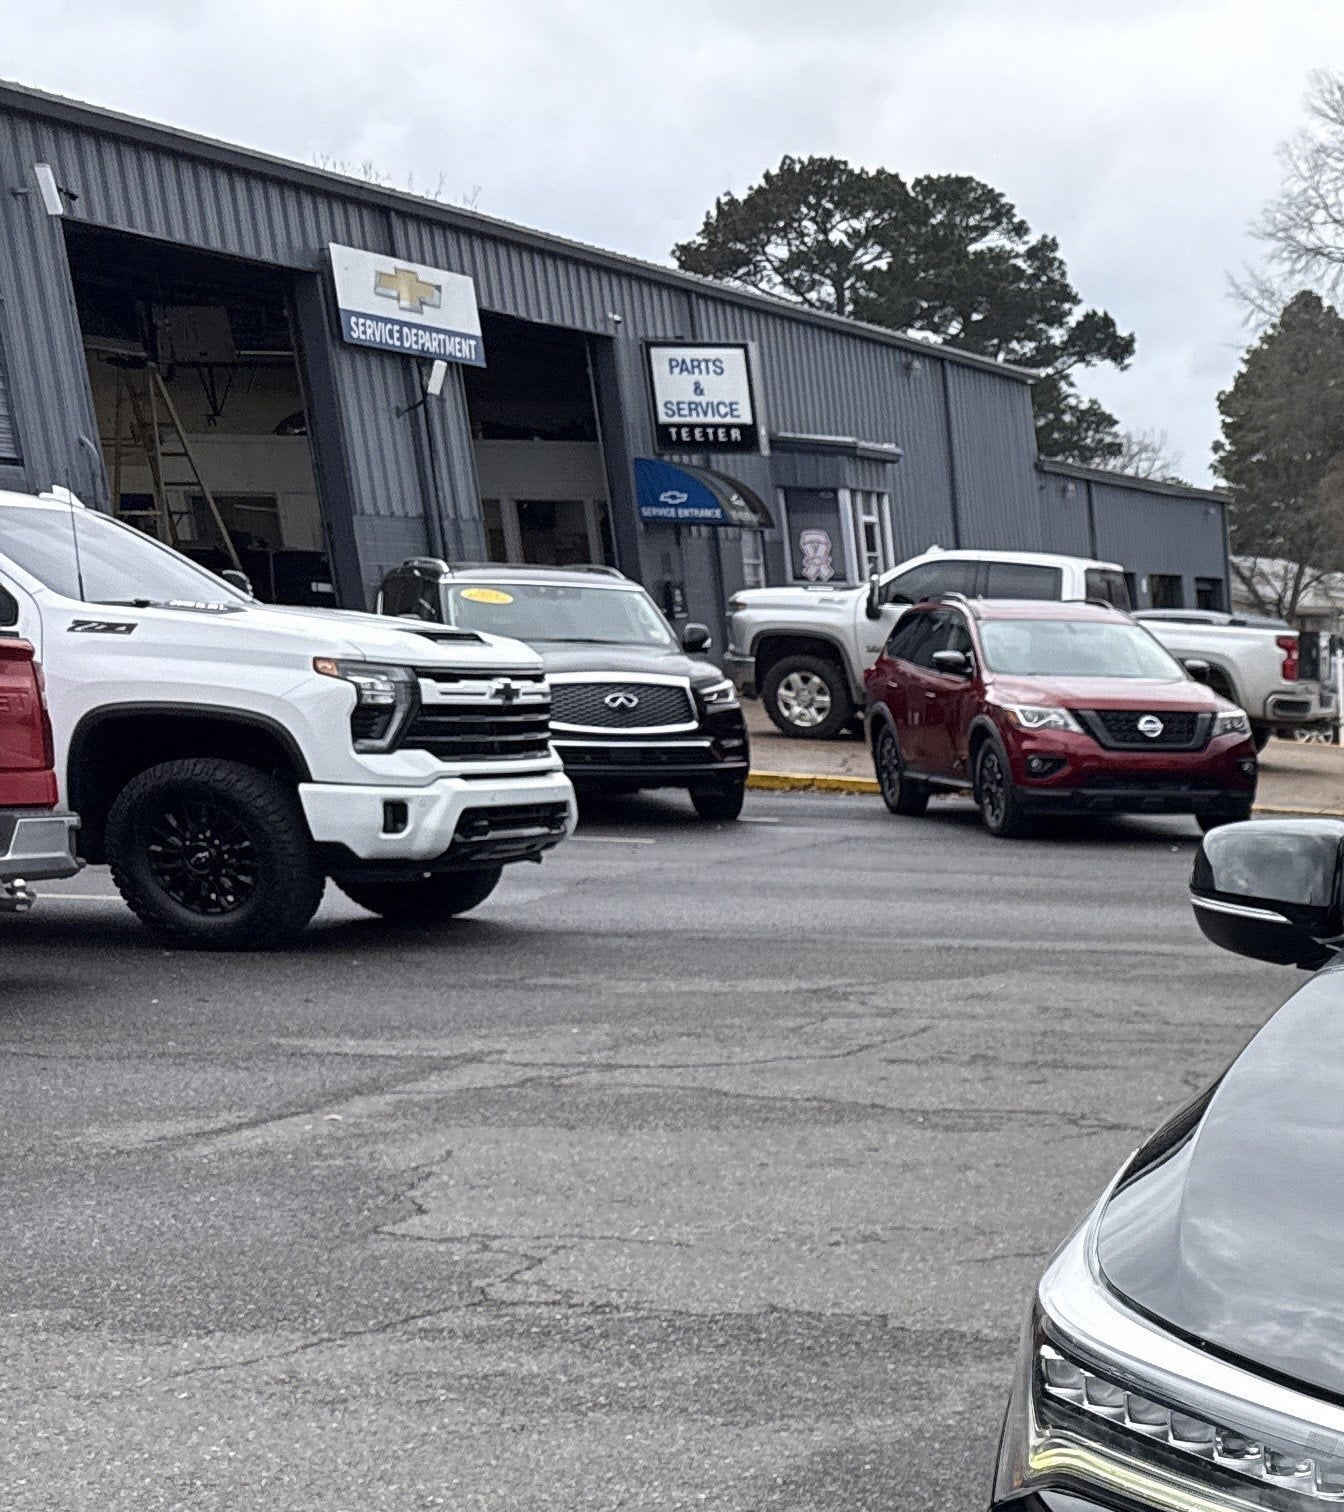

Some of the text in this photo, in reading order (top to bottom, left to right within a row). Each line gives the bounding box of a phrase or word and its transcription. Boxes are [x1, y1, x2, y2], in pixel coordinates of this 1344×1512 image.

[350, 316, 477, 360] SERVICE DEPARTMENT
[668, 358, 725, 376] PARTS
[693, 380, 705, 397] &
[663, 401, 741, 418] SERVICE
[669, 427, 742, 442] TEETER
[641, 506, 676, 518] SERVICE
